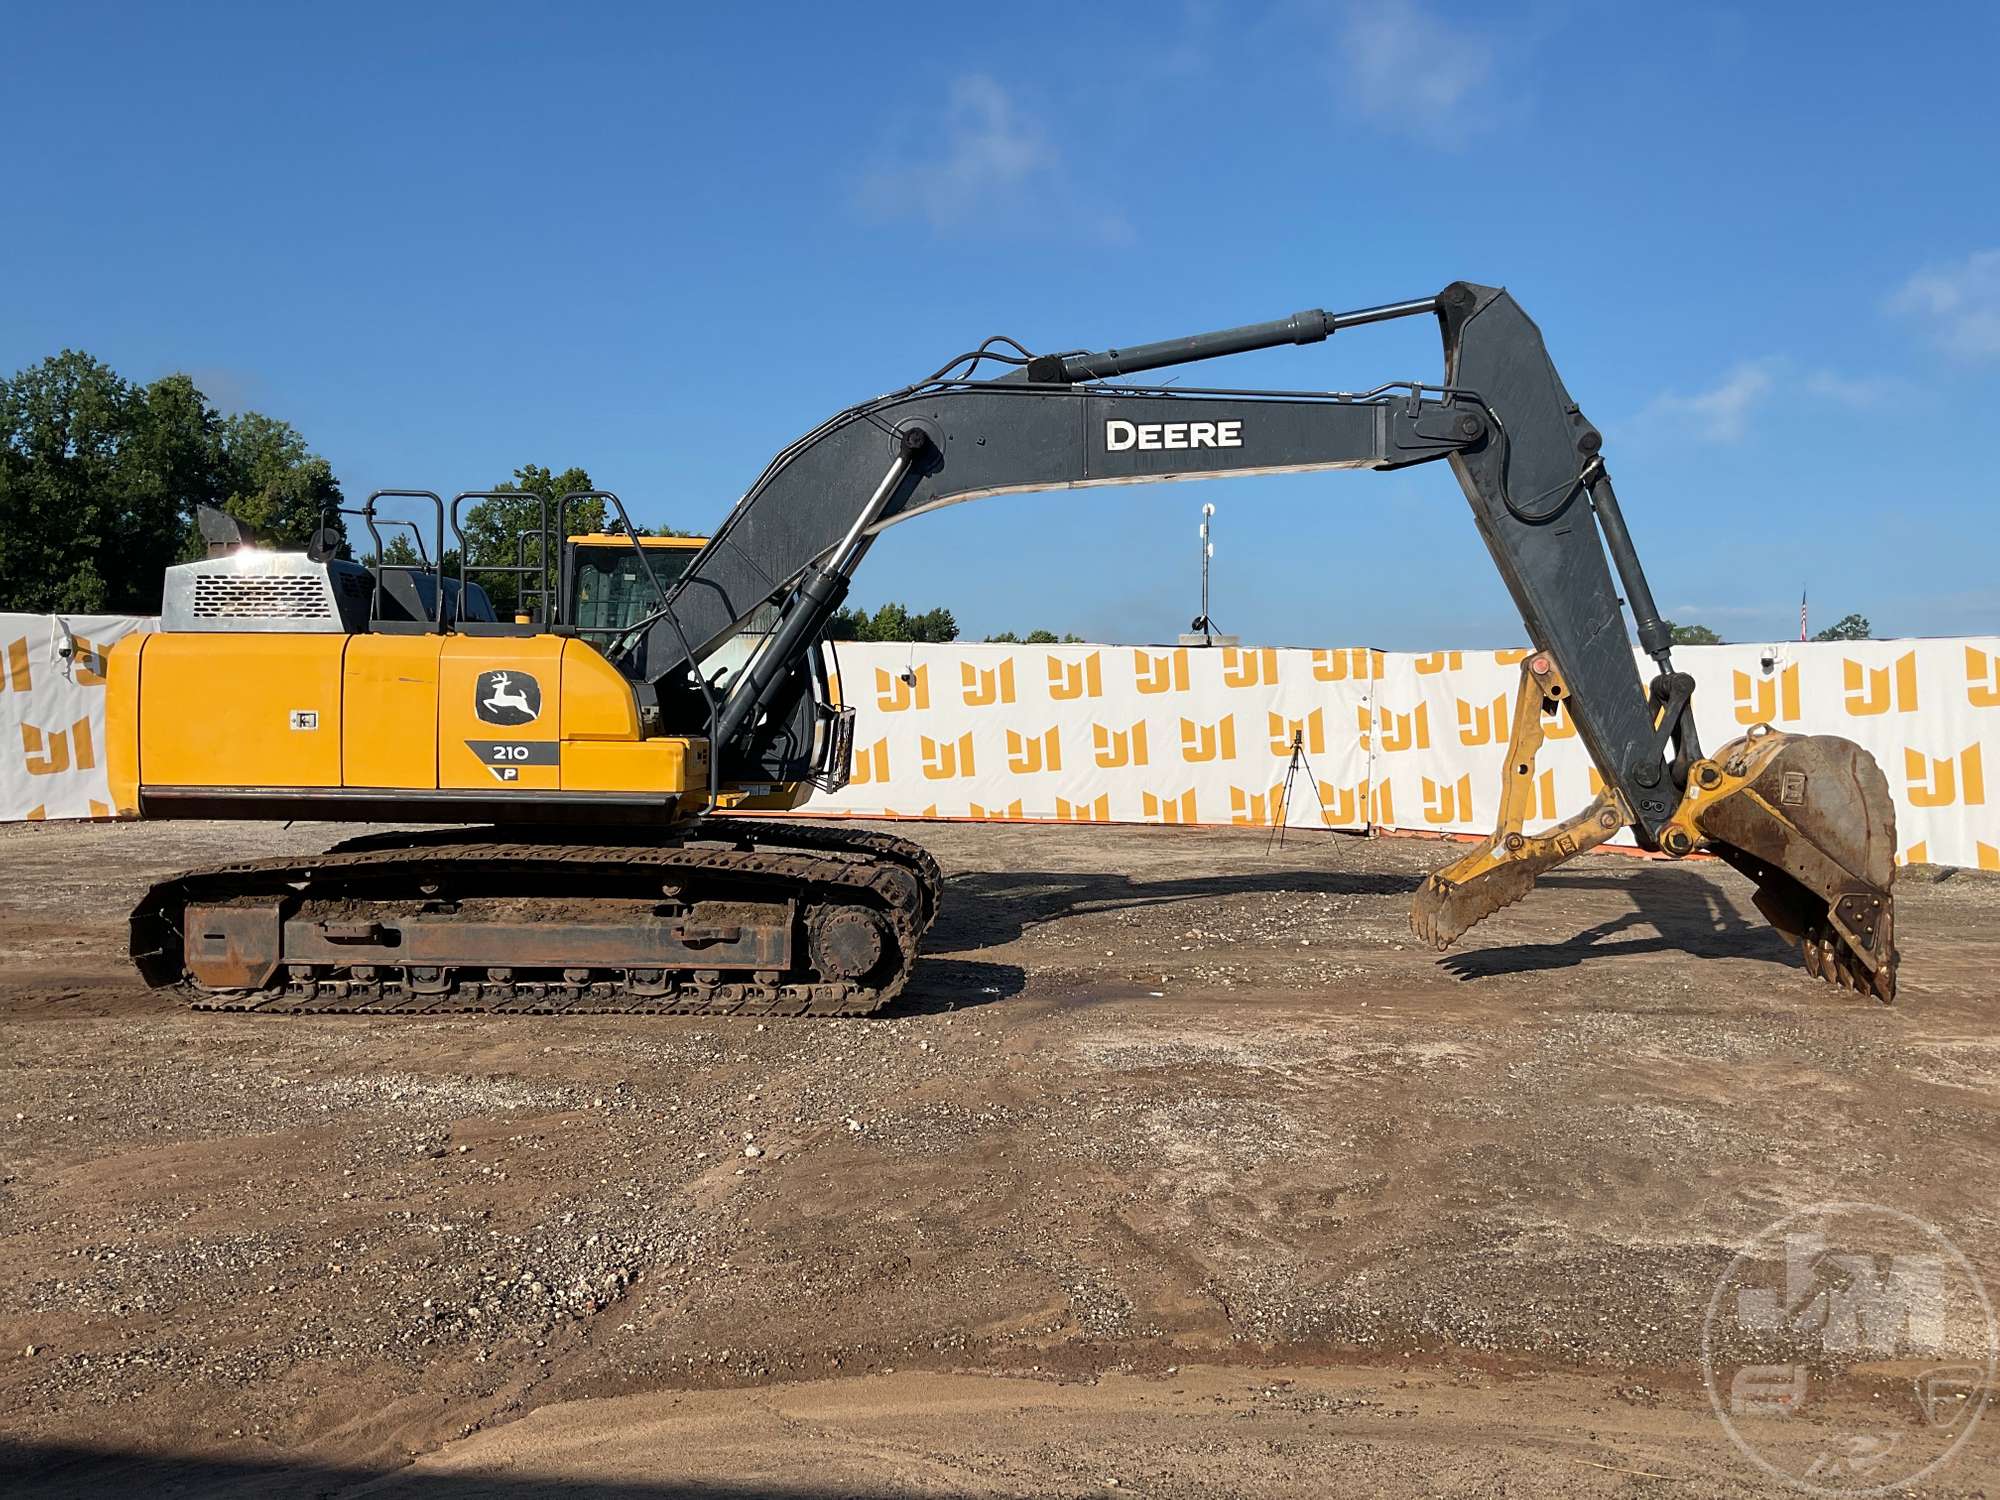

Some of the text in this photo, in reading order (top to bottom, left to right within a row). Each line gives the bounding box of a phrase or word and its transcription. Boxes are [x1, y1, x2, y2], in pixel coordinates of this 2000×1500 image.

[1106, 420, 1242, 451] DEERE
[493, 745, 529, 760] 210
[503, 768, 517, 780] P
